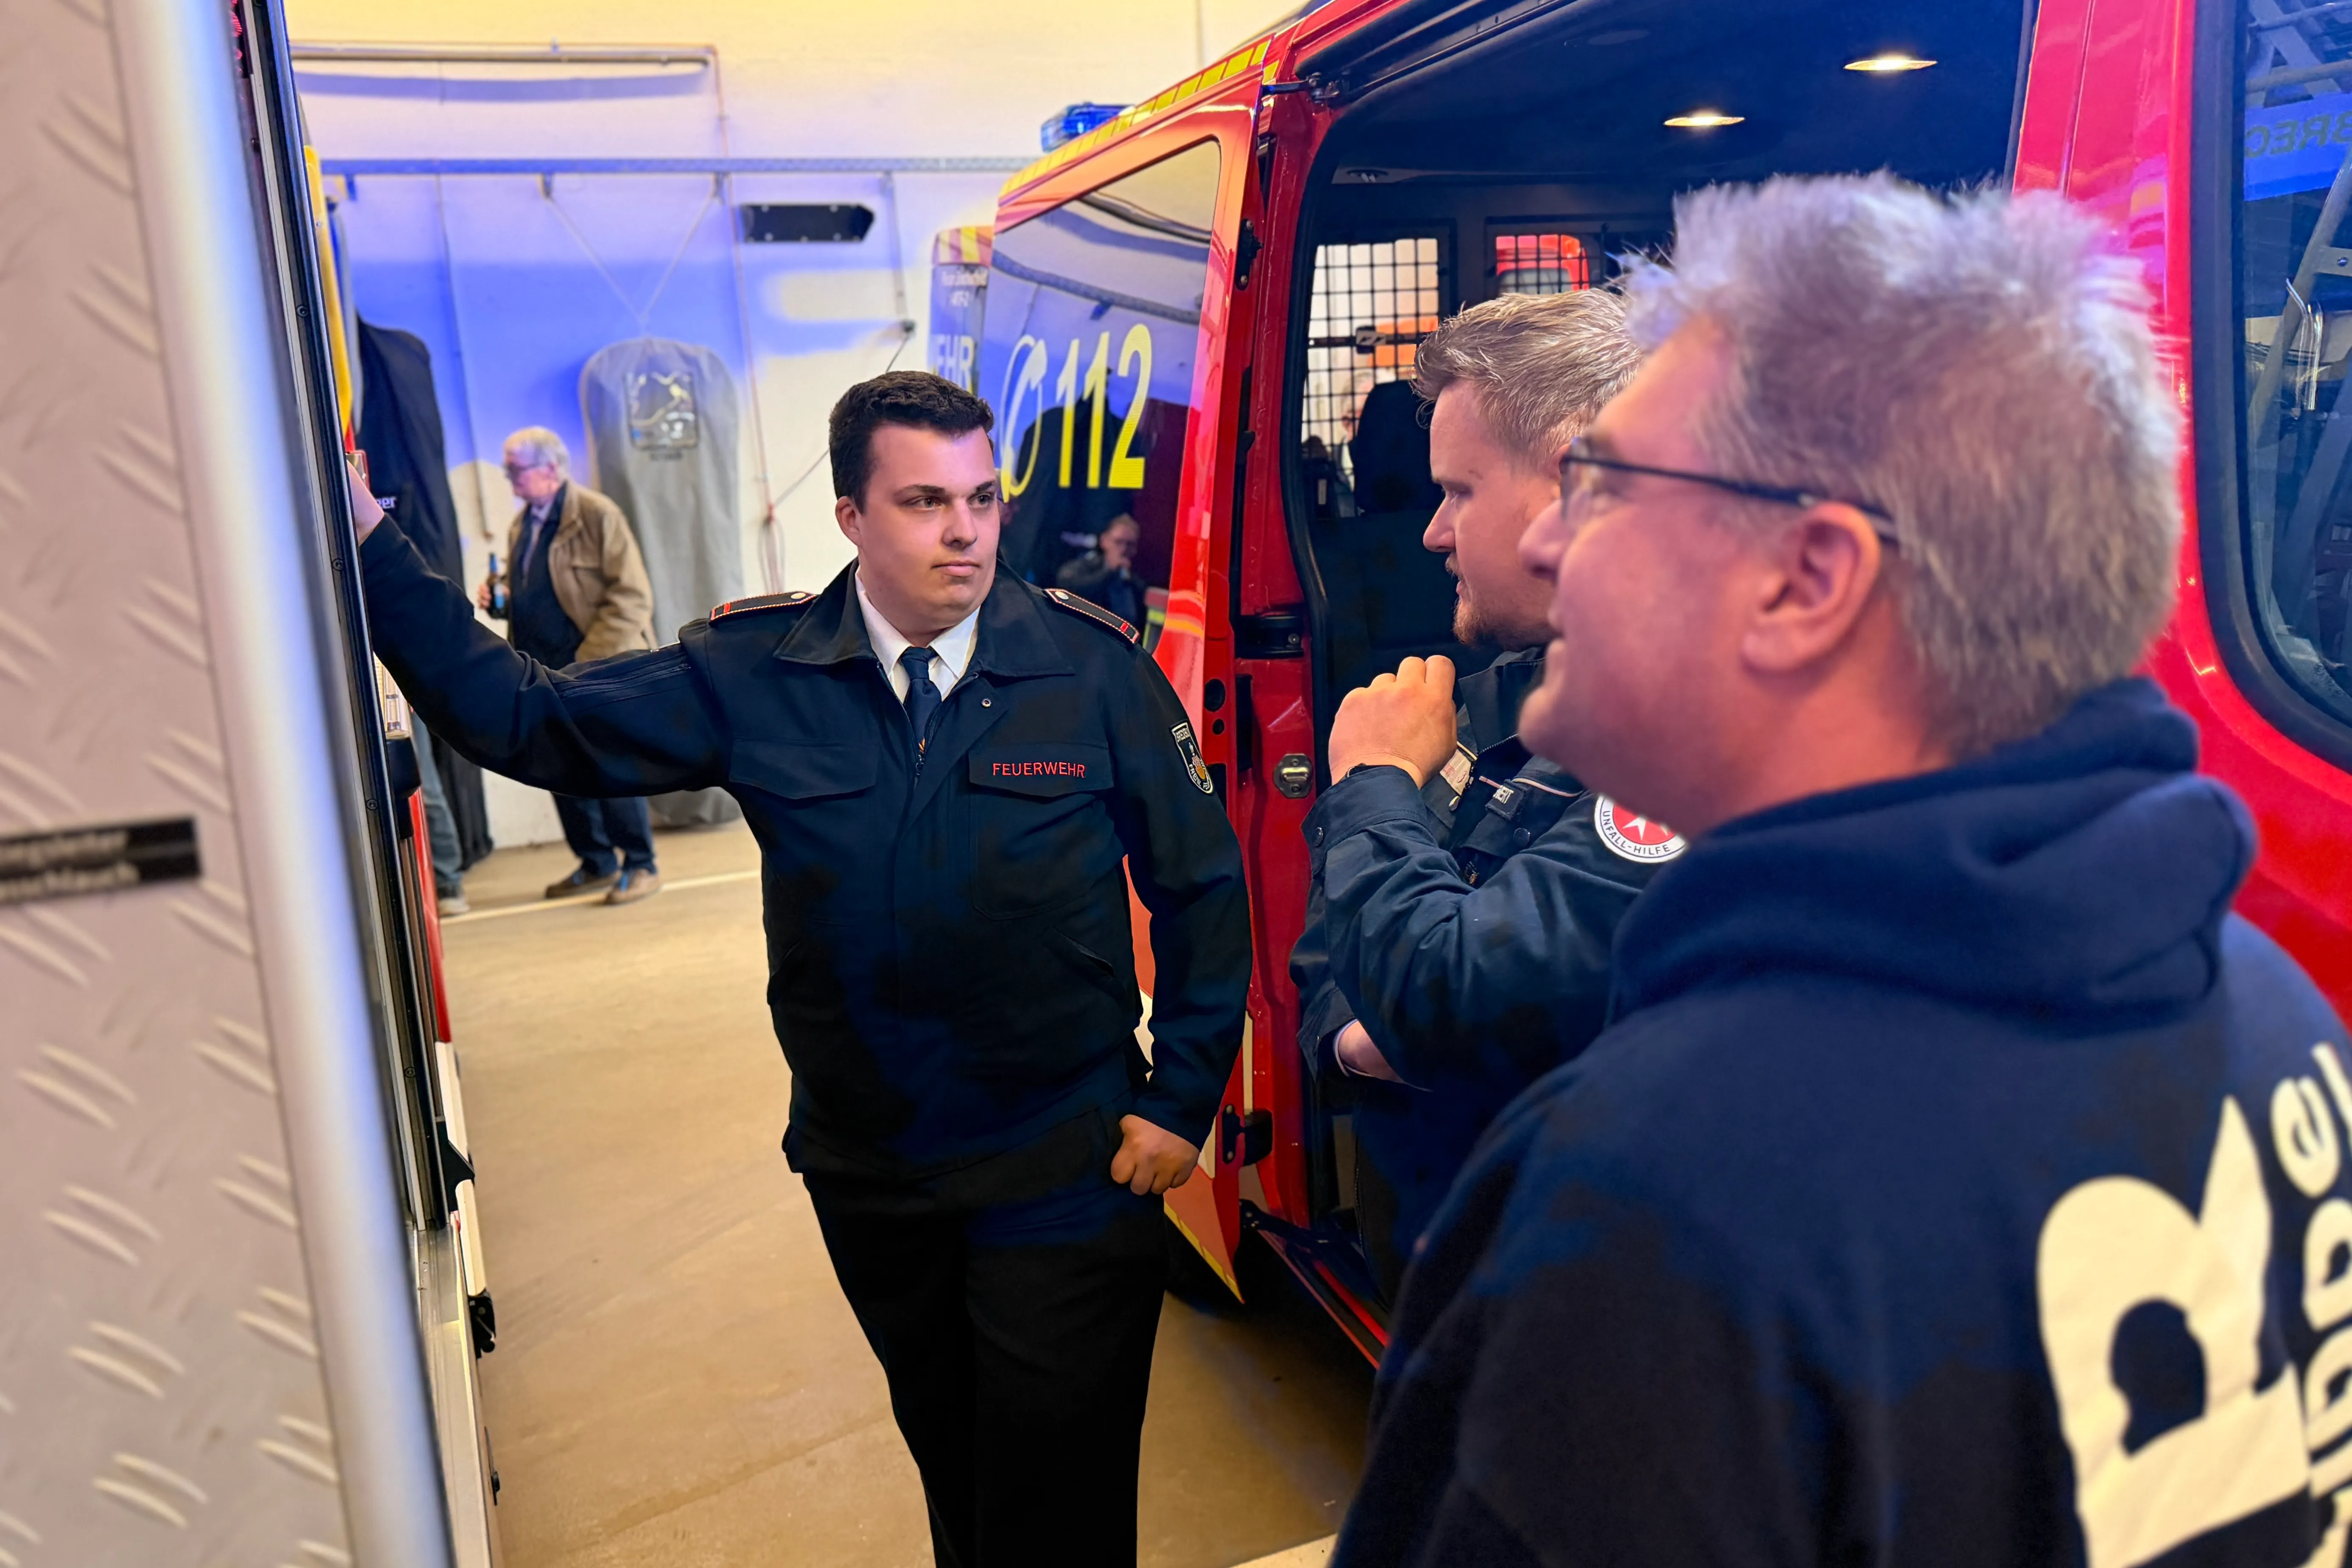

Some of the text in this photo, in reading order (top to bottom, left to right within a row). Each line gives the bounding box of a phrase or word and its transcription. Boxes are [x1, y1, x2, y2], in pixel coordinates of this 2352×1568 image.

[1056, 323, 1152, 489] 112
[993, 762, 1085, 778] FEUERWEHR
[1603, 811, 1671, 855] UNFALL-HILFE
